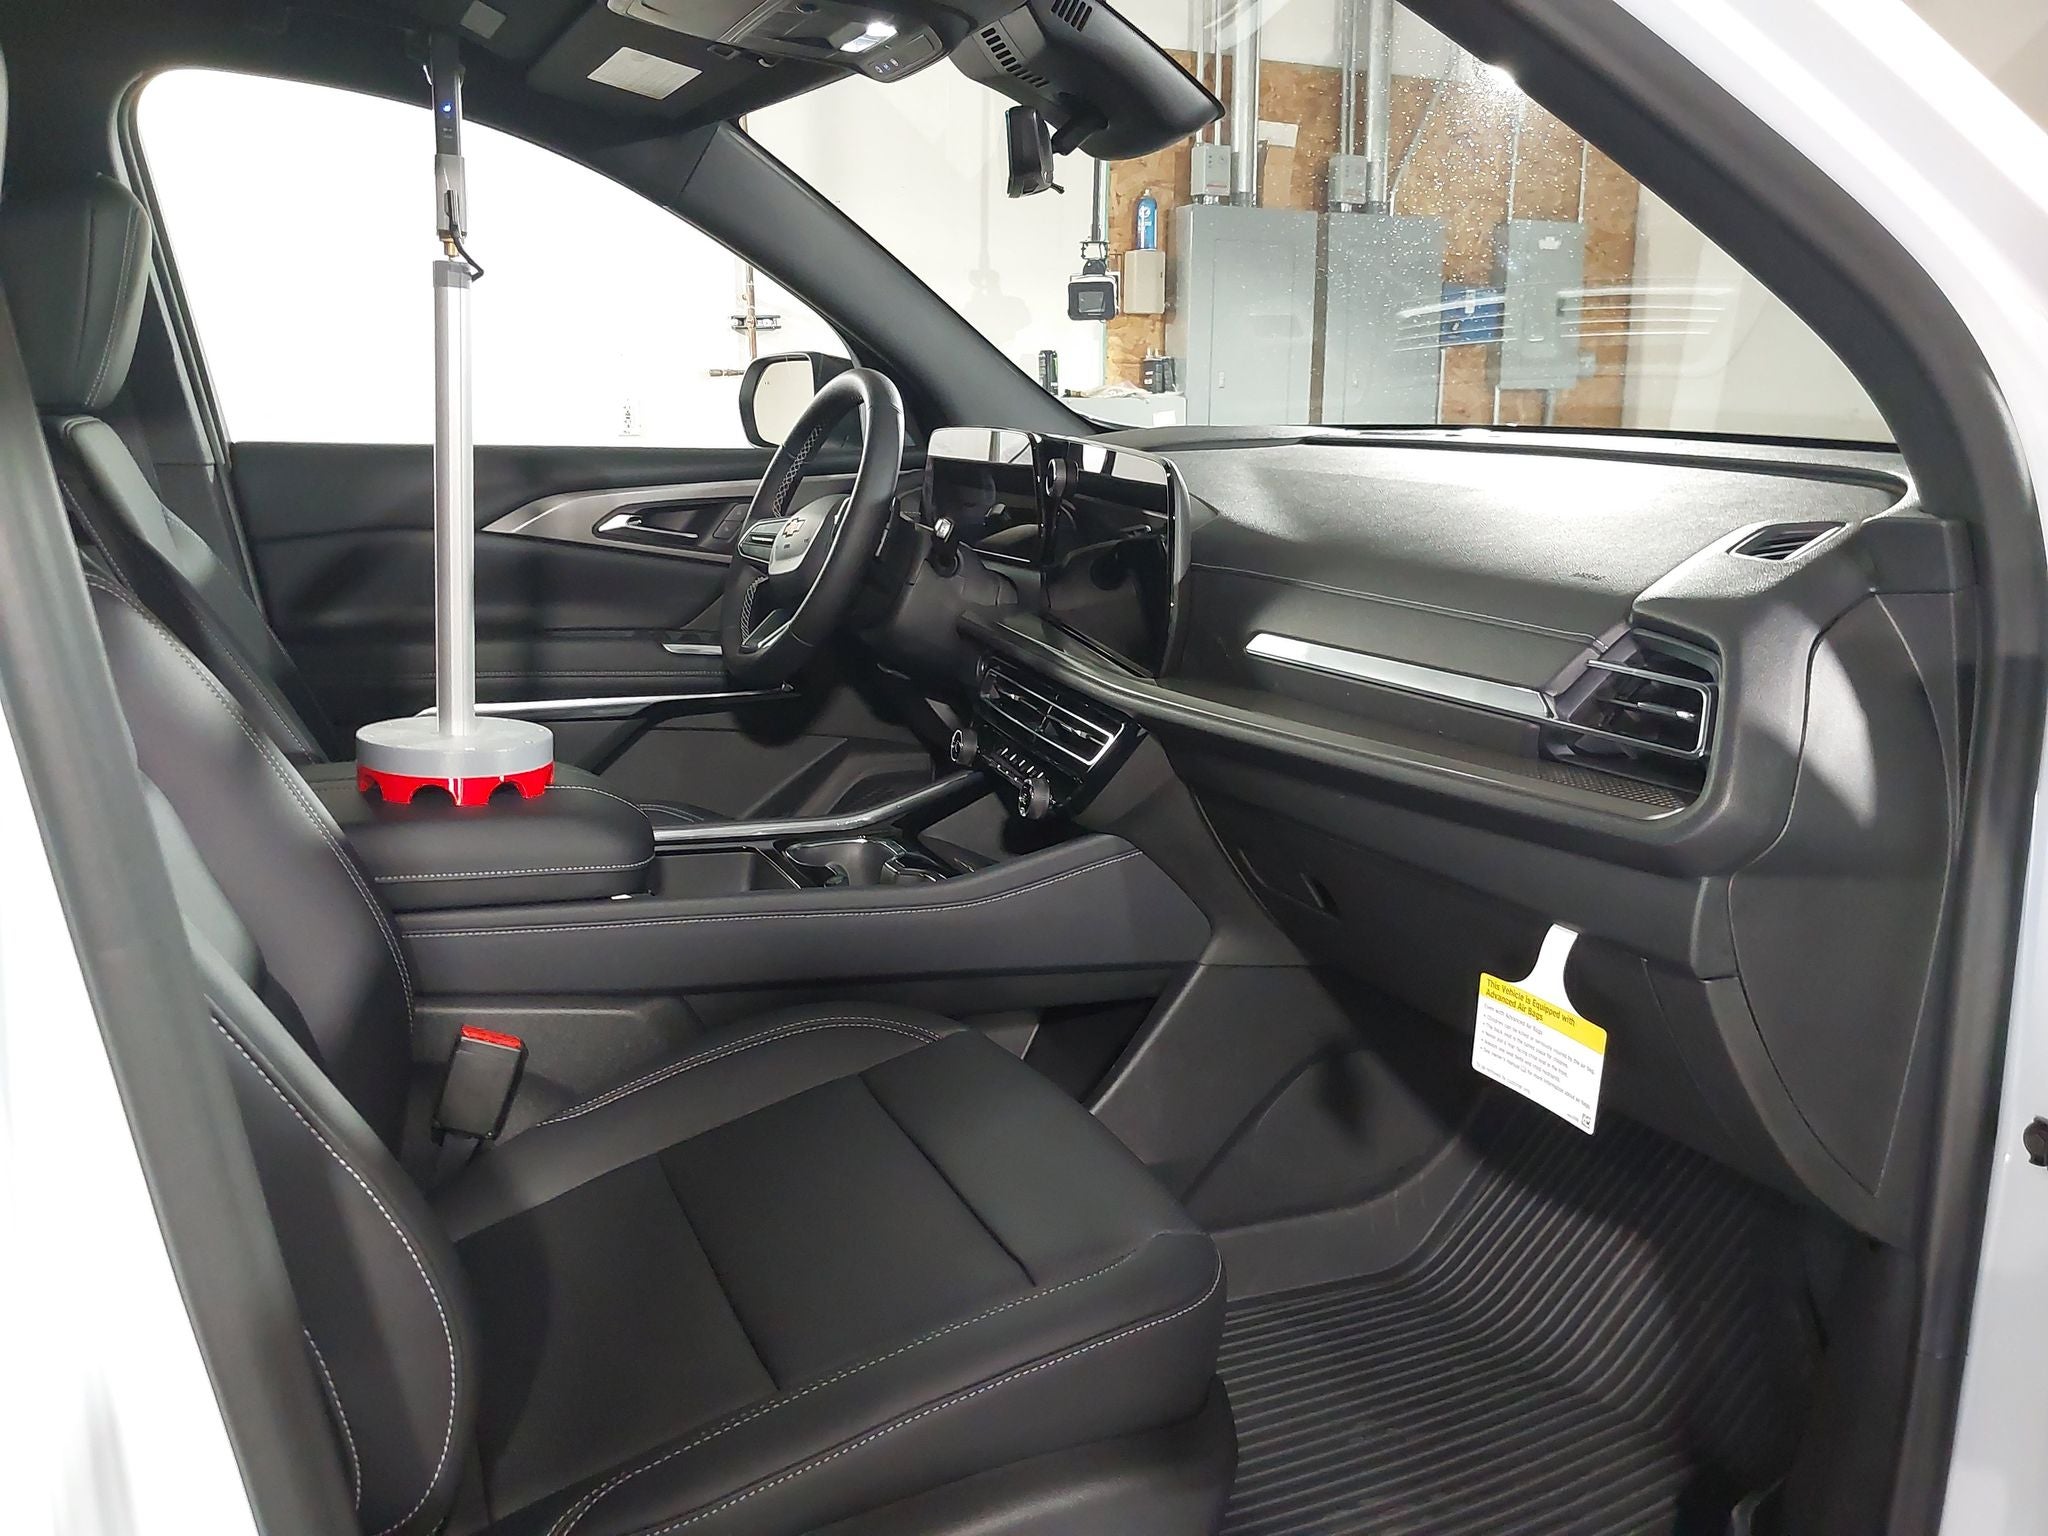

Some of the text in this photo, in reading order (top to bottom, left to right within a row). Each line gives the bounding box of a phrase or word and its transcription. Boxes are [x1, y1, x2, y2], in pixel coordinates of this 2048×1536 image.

[1486, 988, 1516, 1009] Advanced
[1517, 1002, 1527, 1013] Air
[1487, 979, 1500, 991] This
[1502, 984, 1524, 1001] Vehicle
[1532, 998, 1561, 1019] Equipped
[1561, 1013, 1576, 1026] with
